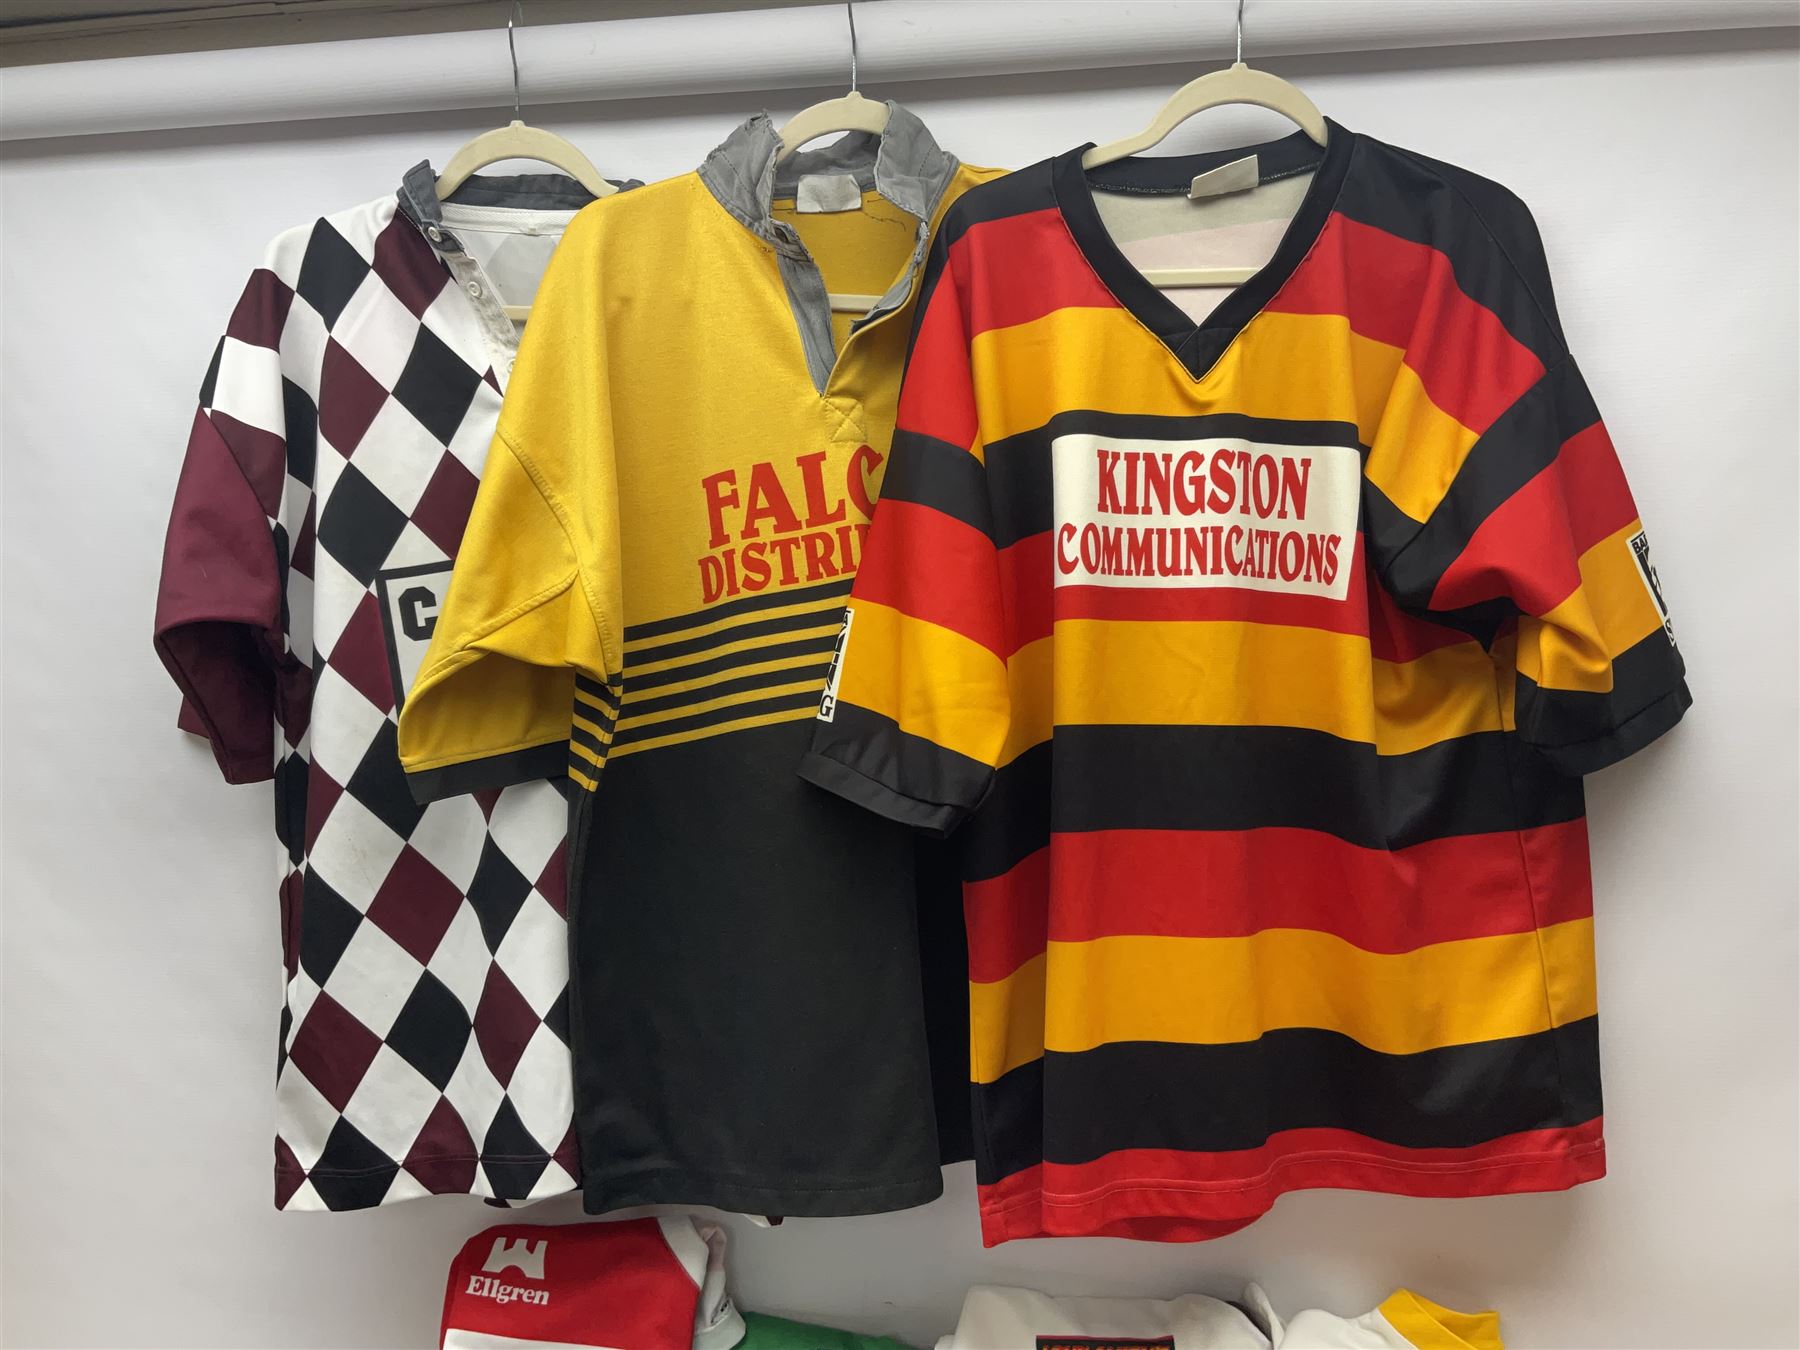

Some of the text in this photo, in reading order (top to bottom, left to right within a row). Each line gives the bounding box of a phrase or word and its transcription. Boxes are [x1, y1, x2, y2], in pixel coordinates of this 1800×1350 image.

[1097, 449, 1312, 520] KINGSTON
[1057, 522, 1341, 586] COMMUNICATIONS
[465, 1275, 550, 1305] Ellgren
